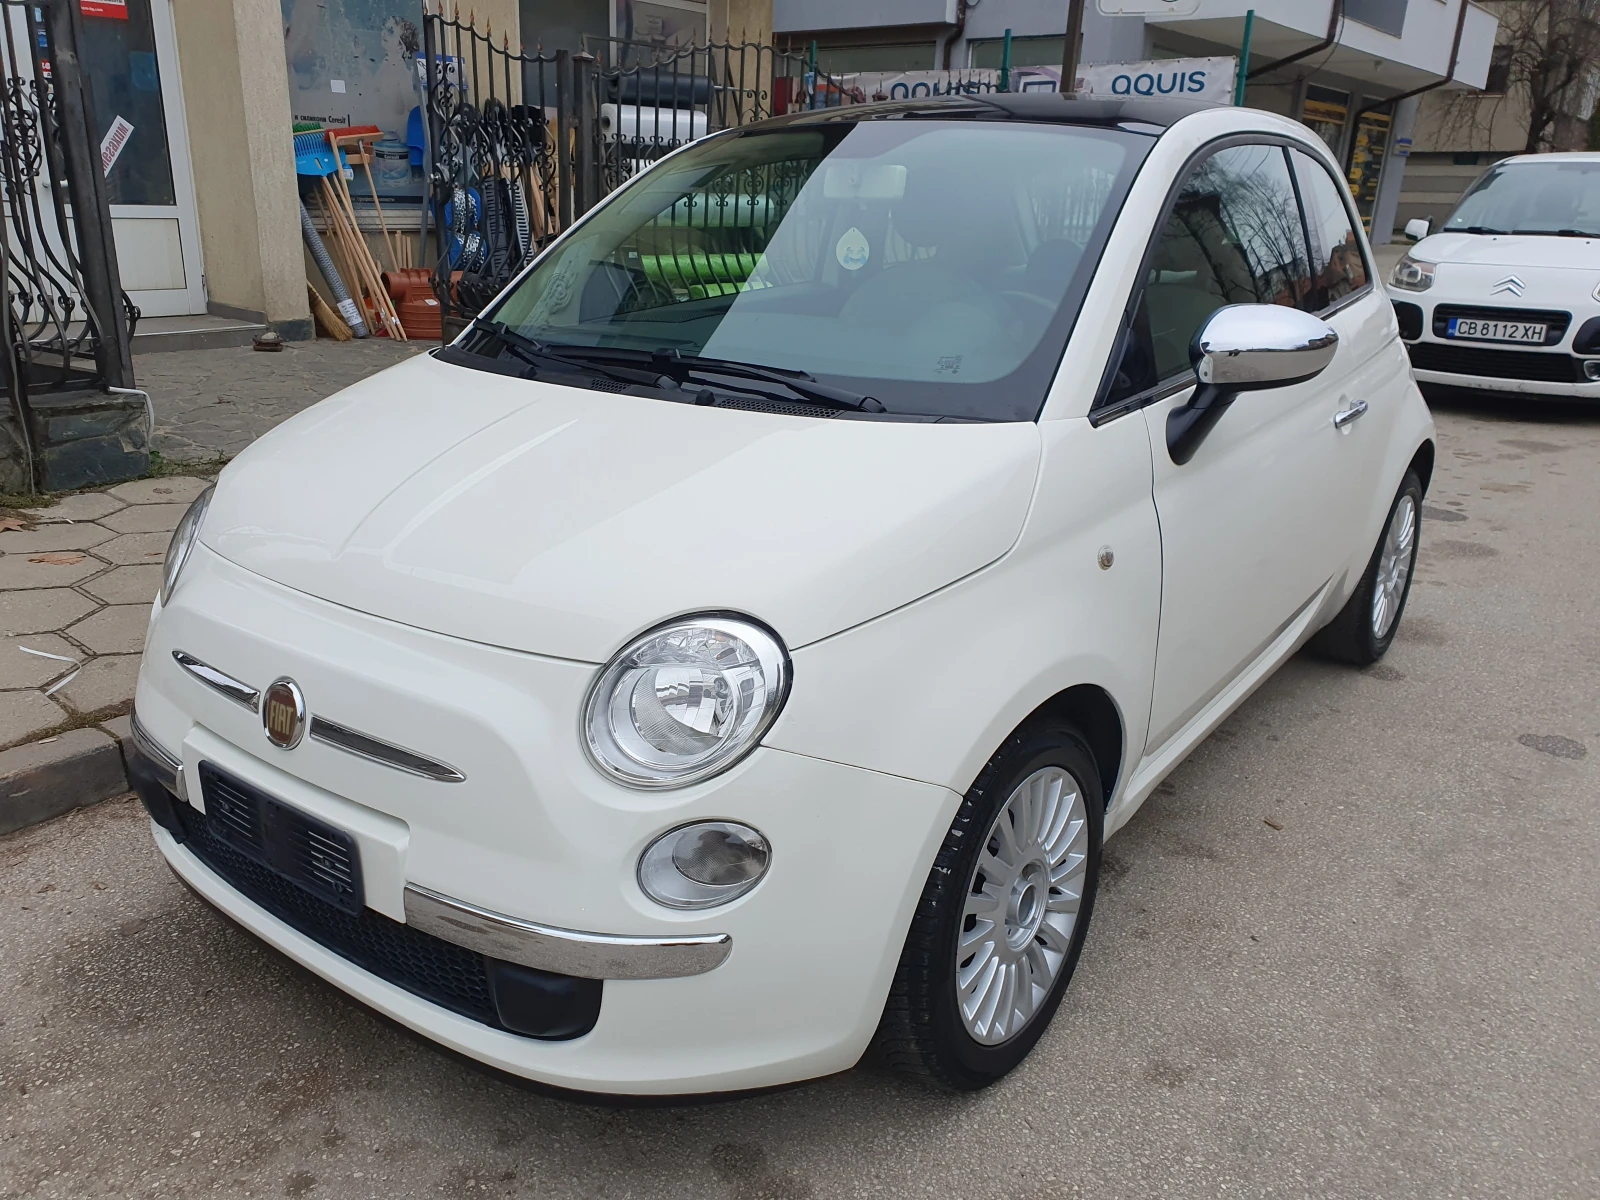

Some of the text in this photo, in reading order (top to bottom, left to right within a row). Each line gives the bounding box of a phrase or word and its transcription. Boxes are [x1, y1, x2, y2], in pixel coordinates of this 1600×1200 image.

[1458, 321, 1544, 340] CB 8112 XH
[269, 700, 294, 735] FIAT
